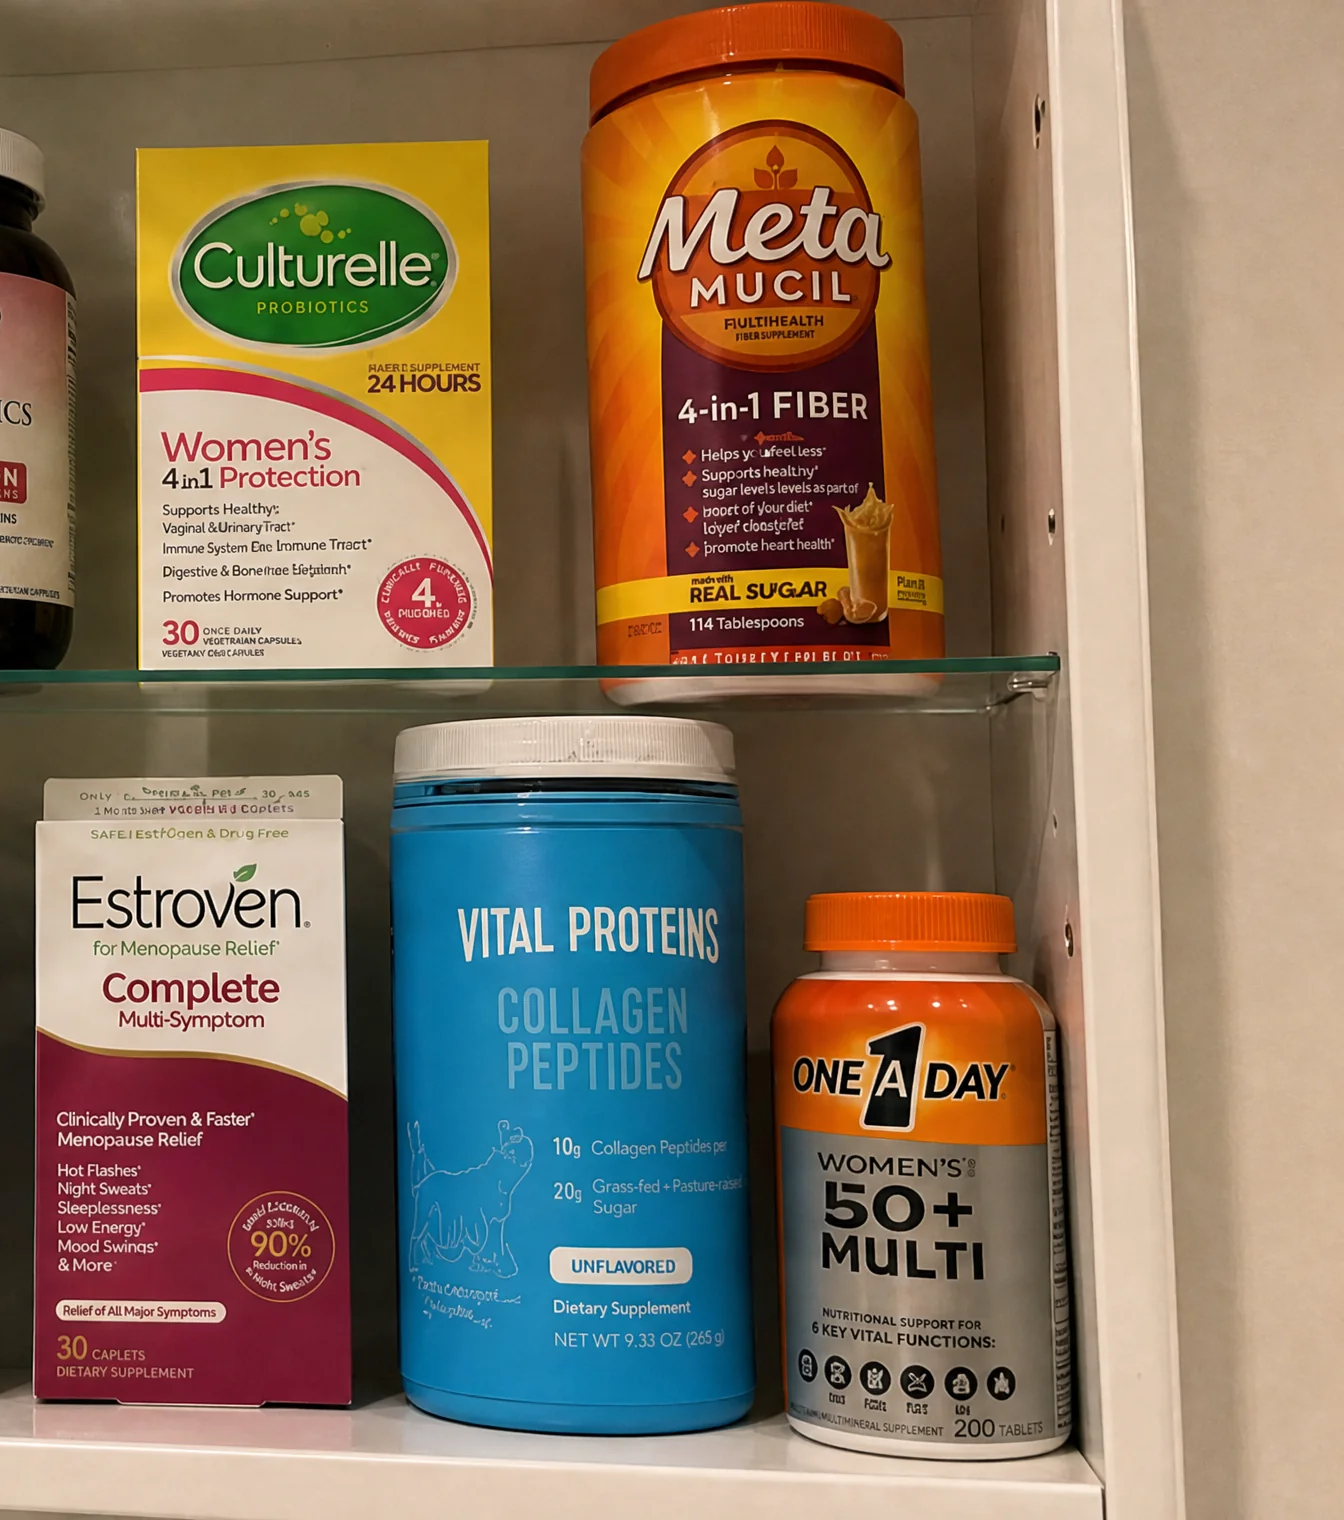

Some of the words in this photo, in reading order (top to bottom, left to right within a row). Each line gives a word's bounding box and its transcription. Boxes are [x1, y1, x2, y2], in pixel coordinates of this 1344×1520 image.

[638, 186, 891, 280] Meta
[194, 240, 432, 289] Culturelle
[690, 270, 851, 308] MUCIL
[257, 300, 369, 315] PROBIOTICS
[761, 329, 816, 340] SUPPLEMENT
[410, 363, 481, 373] SUPPLEMENT
[367, 374, 396, 393] 24
[399, 373, 482, 393] HOURS
[678, 391, 759, 424] 4-in-1
[773, 391, 868, 420] FIBER
[161, 429, 332, 463] Women's
[701, 448, 740, 463] Helps
[220, 464, 361, 489] Protection
[701, 466, 761, 483] Supports
[702, 486, 738, 500] sugar
[740, 482, 776, 496] levels
[777, 481, 812, 495] levels
[813, 484, 825, 493] as
[826, 483, 848, 496] part
[848, 483, 859, 494] of
[162, 504, 220, 518] Supports
[742, 501, 756, 515] of
[757, 501, 784, 516] your
[162, 522, 206, 536] Vaginal
[207, 542, 248, 556] System
[704, 541, 758, 557] promote
[761, 538, 794, 551] heart
[162, 566, 218, 580] Digestive
[220, 565, 230, 577] &
[162, 590, 221, 603] Promotes
[224, 589, 282, 602] Hormone
[690, 584, 741, 604] REAL
[162, 620, 200, 646] 30
[203, 626, 230, 635] ONCE
[233, 626, 262, 635] DAILY
[689, 617, 714, 632] 114
[716, 615, 805, 631] Tablespoons
[80, 792, 112, 801] ONLY
[261, 790, 277, 798] 30
[206, 828, 216, 838] &
[219, 828, 254, 840] Drug
[258, 828, 289, 838] Free
[72, 875, 302, 929] Estroven
[458, 907, 554, 963] VITAL
[569, 906, 719, 964] PROTEINS
[93, 940, 118, 956] for
[121, 941, 221, 959] Menopause
[103, 972, 280, 1010] Complete
[498, 987, 688, 1035] COLLAGEN
[119, 1010, 265, 1032] Multi-Symptom
[508, 1041, 683, 1090] PEPTIDES
[793, 1056, 864, 1096] ONE
[875, 1060, 907, 1097] A
[924, 1062, 1008, 1100] DAY
[57, 1111, 125, 1130] Clinically
[128, 1111, 187, 1127] Proven
[190, 1112, 202, 1127] &
[58, 1132, 154, 1150] Menopause
[158, 1131, 203, 1147] Relief
[553, 1137, 581, 1159] 10g
[591, 1139, 657, 1159] Collagen
[659, 1138, 712, 1158] Peptides
[58, 1163, 84, 1177] Hot
[817, 1152, 962, 1178] WOMEN'S
[58, 1182, 96, 1198] Night
[553, 1182, 582, 1203] 20g
[592, 1179, 660, 1197] Grass-fed
[593, 1199, 637, 1218] Sugar
[824, 1181, 973, 1232] 50+
[58, 1221, 89, 1234] Low
[58, 1240, 100, 1253] Mood
[250, 1230, 312, 1258] 90%
[58, 1259, 69, 1272] &
[72, 1258, 113, 1272] More
[253, 1260, 298, 1271] Reduction
[571, 1258, 676, 1275] UNFLAVORED
[63, 1304, 94, 1317] Relief
[95, 1305, 106, 1317] of
[107, 1305, 123, 1317] All
[124, 1305, 154, 1319] Major
[157, 1306, 216, 1320] Symptoms
[553, 1300, 608, 1318] Dietary
[611, 1300, 691, 1318] Supplement
[822, 1307, 897, 1327] NUTRITIONAL
[900, 1317, 955, 1330] SUPPORT
[958, 1319, 981, 1331] FOR
[554, 1333, 589, 1348] NET
[592, 1333, 619, 1348] WT
[624, 1333, 656, 1348] 9.33
[659, 1332, 683, 1347] OZ
[714, 1329, 725, 1347] g)
[812, 1321, 820, 1334] 6
[822, 1324, 849, 1339] KEY
[851, 1328, 893, 1344] VITAL
[897, 1333, 996, 1349] FUNCTIONS:
[56, 1335, 88, 1360] 30
[92, 1349, 145, 1361] CAPLETS
[57, 1366, 108, 1378] DIETARY
[111, 1366, 194, 1379] SUPPLEMENT
[883, 1421, 944, 1437] SUPPLEMENT
[954, 1418, 995, 1438] 200
[999, 1421, 1043, 1437] TABLETS
